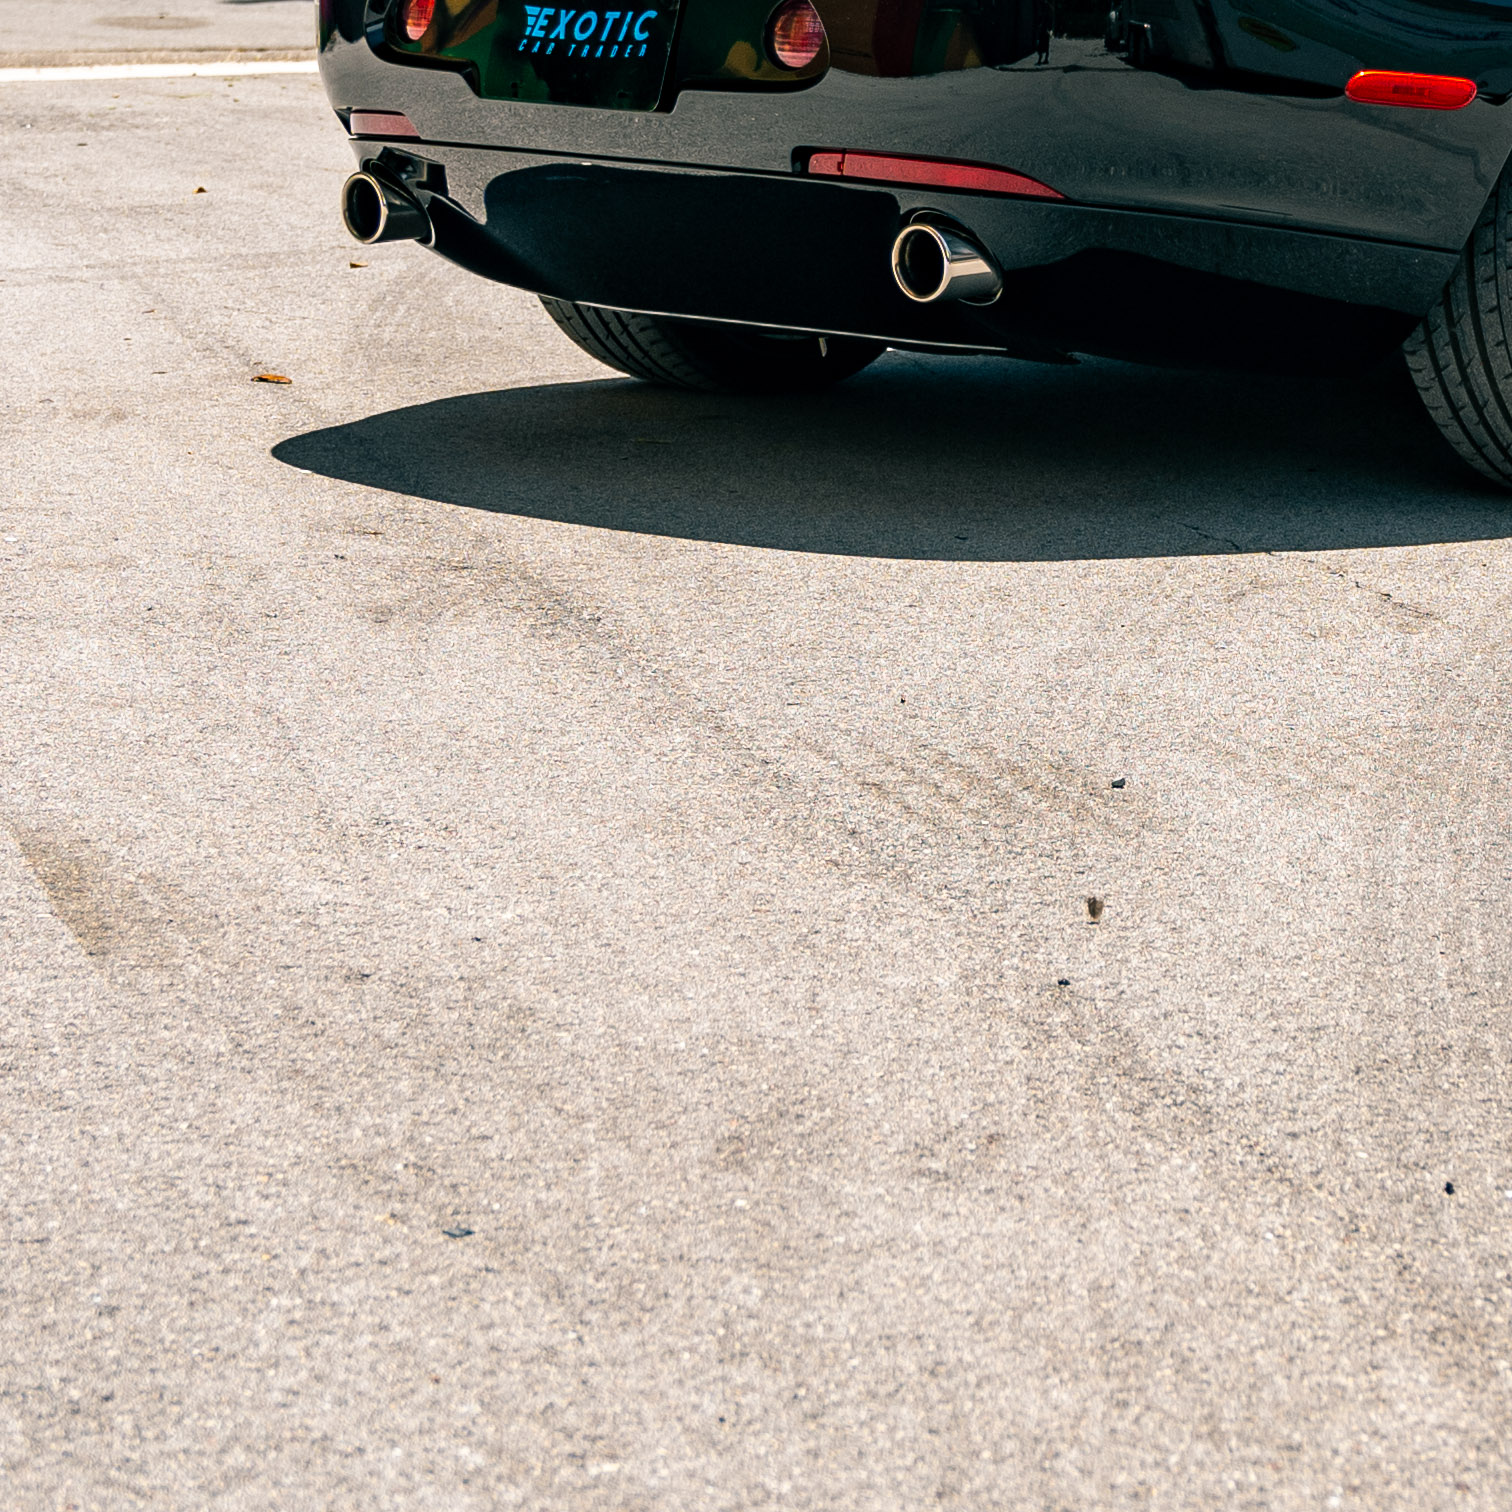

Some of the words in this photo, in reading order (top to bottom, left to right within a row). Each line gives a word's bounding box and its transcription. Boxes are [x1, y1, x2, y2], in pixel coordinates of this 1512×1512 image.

[525, 5, 658, 41] EXOTIC
[518, 39, 555, 55] CAR
[568, 43, 647, 58] TRADER
